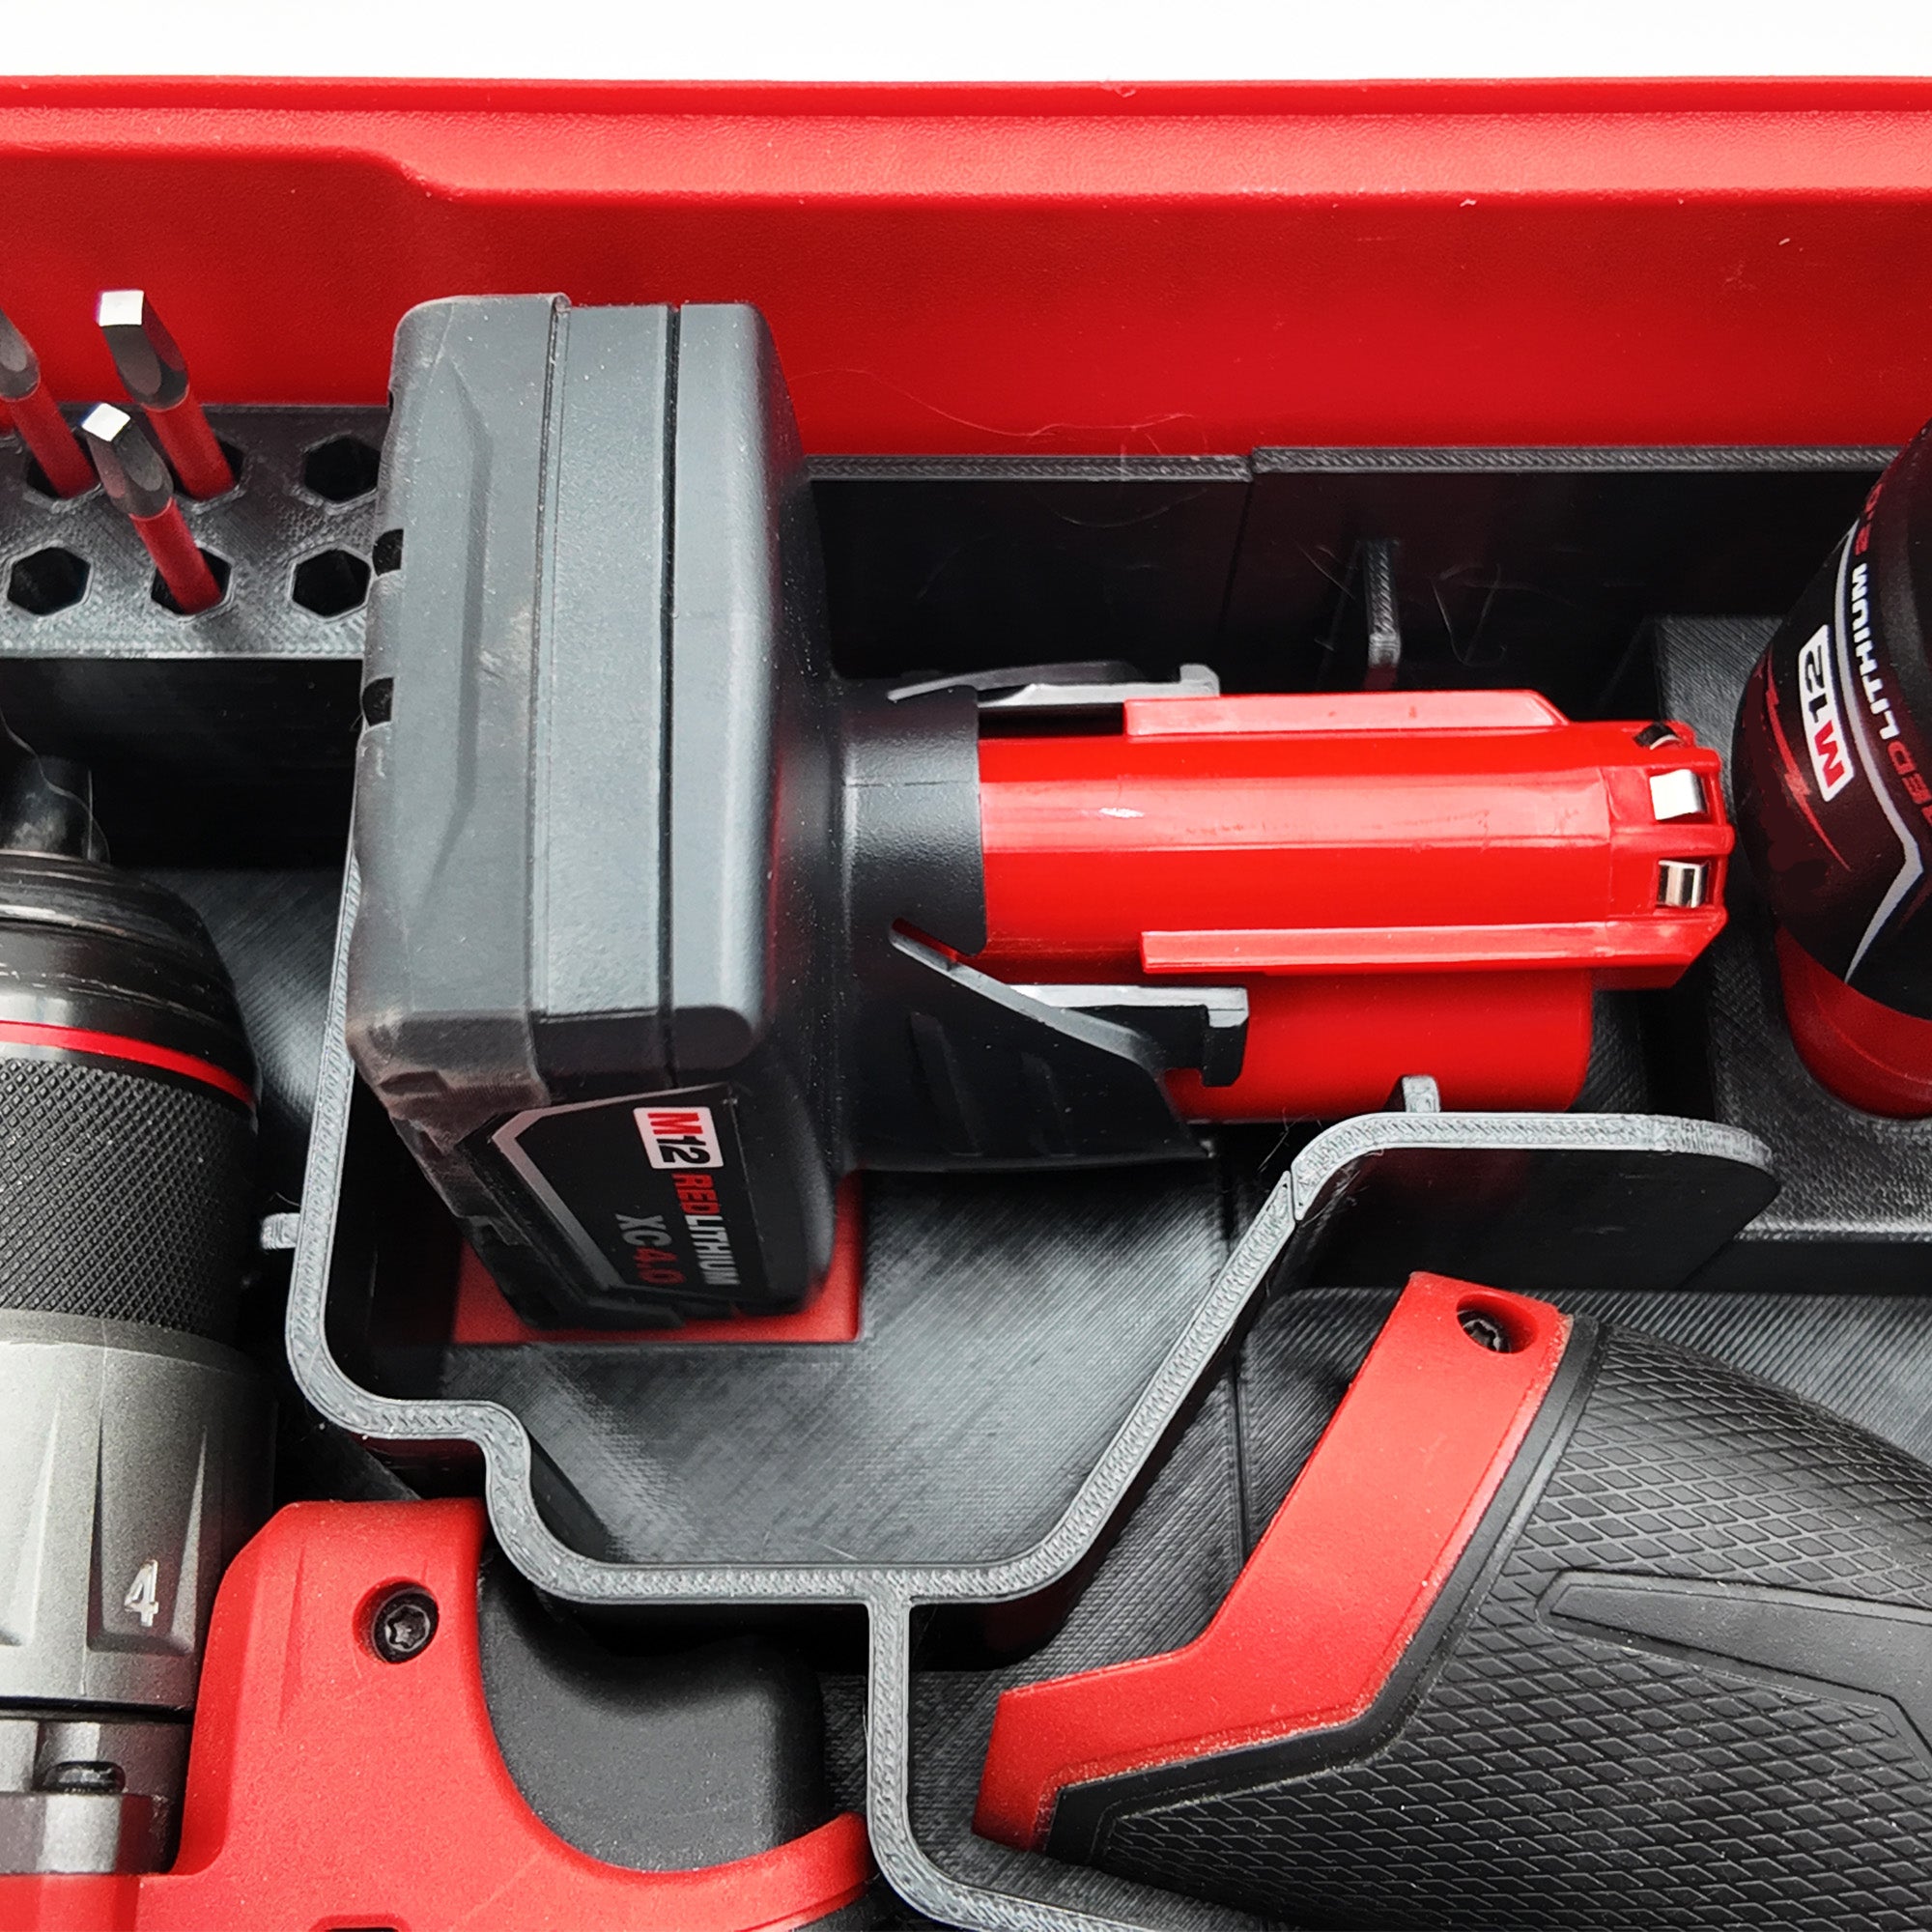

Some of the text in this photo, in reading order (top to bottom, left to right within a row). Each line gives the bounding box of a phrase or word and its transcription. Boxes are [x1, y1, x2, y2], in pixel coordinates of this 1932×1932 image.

[1804, 644, 1845, 788] M12
[647, 1112, 741, 1285] M12 REDLITHIUM
[124, 1558, 159, 1627] 4
